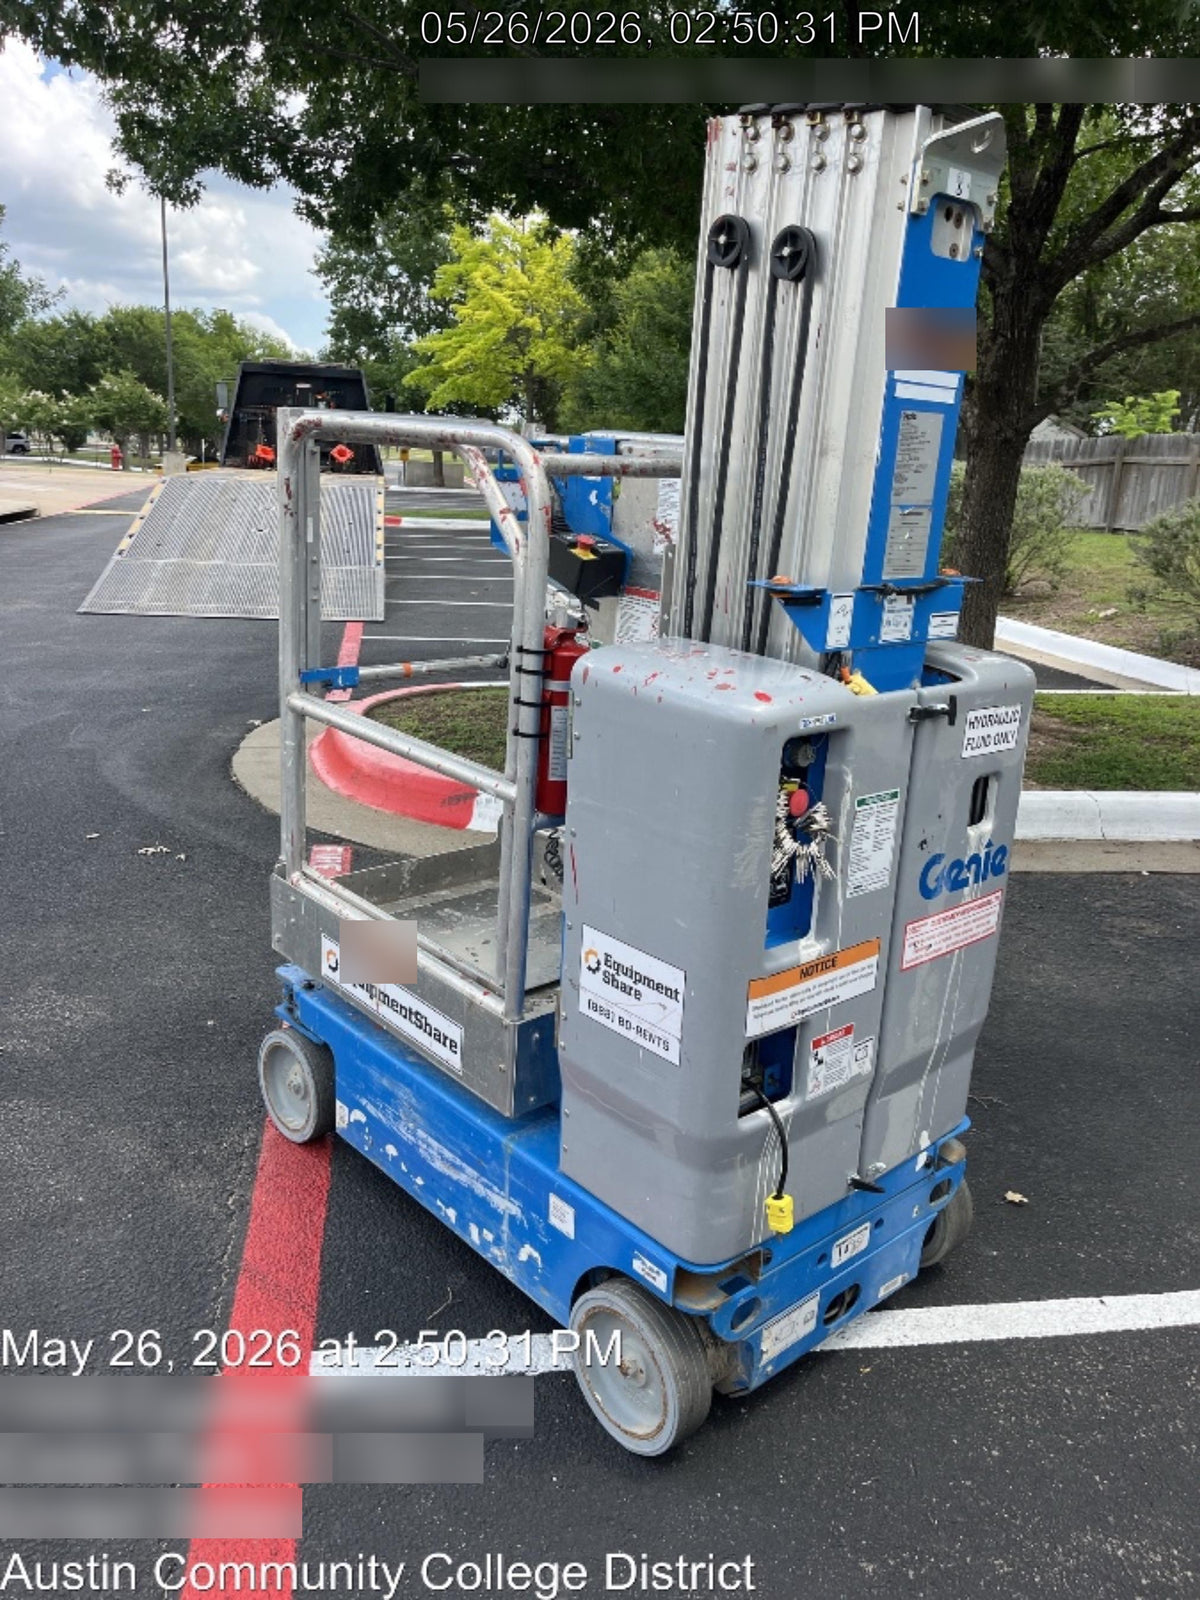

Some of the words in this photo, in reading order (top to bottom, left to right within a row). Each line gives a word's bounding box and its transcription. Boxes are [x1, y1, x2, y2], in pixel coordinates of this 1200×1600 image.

[968, 709, 1020, 730] HYDRAULIC
[964, 733, 992, 751] FLUID
[993, 730, 1017, 746] ONLY
[919, 838, 1008, 900] Genie
[603, 952, 681, 1003] Equipment
[799, 956, 838, 980] NOTICE
[602, 970, 643, 1001] Share
